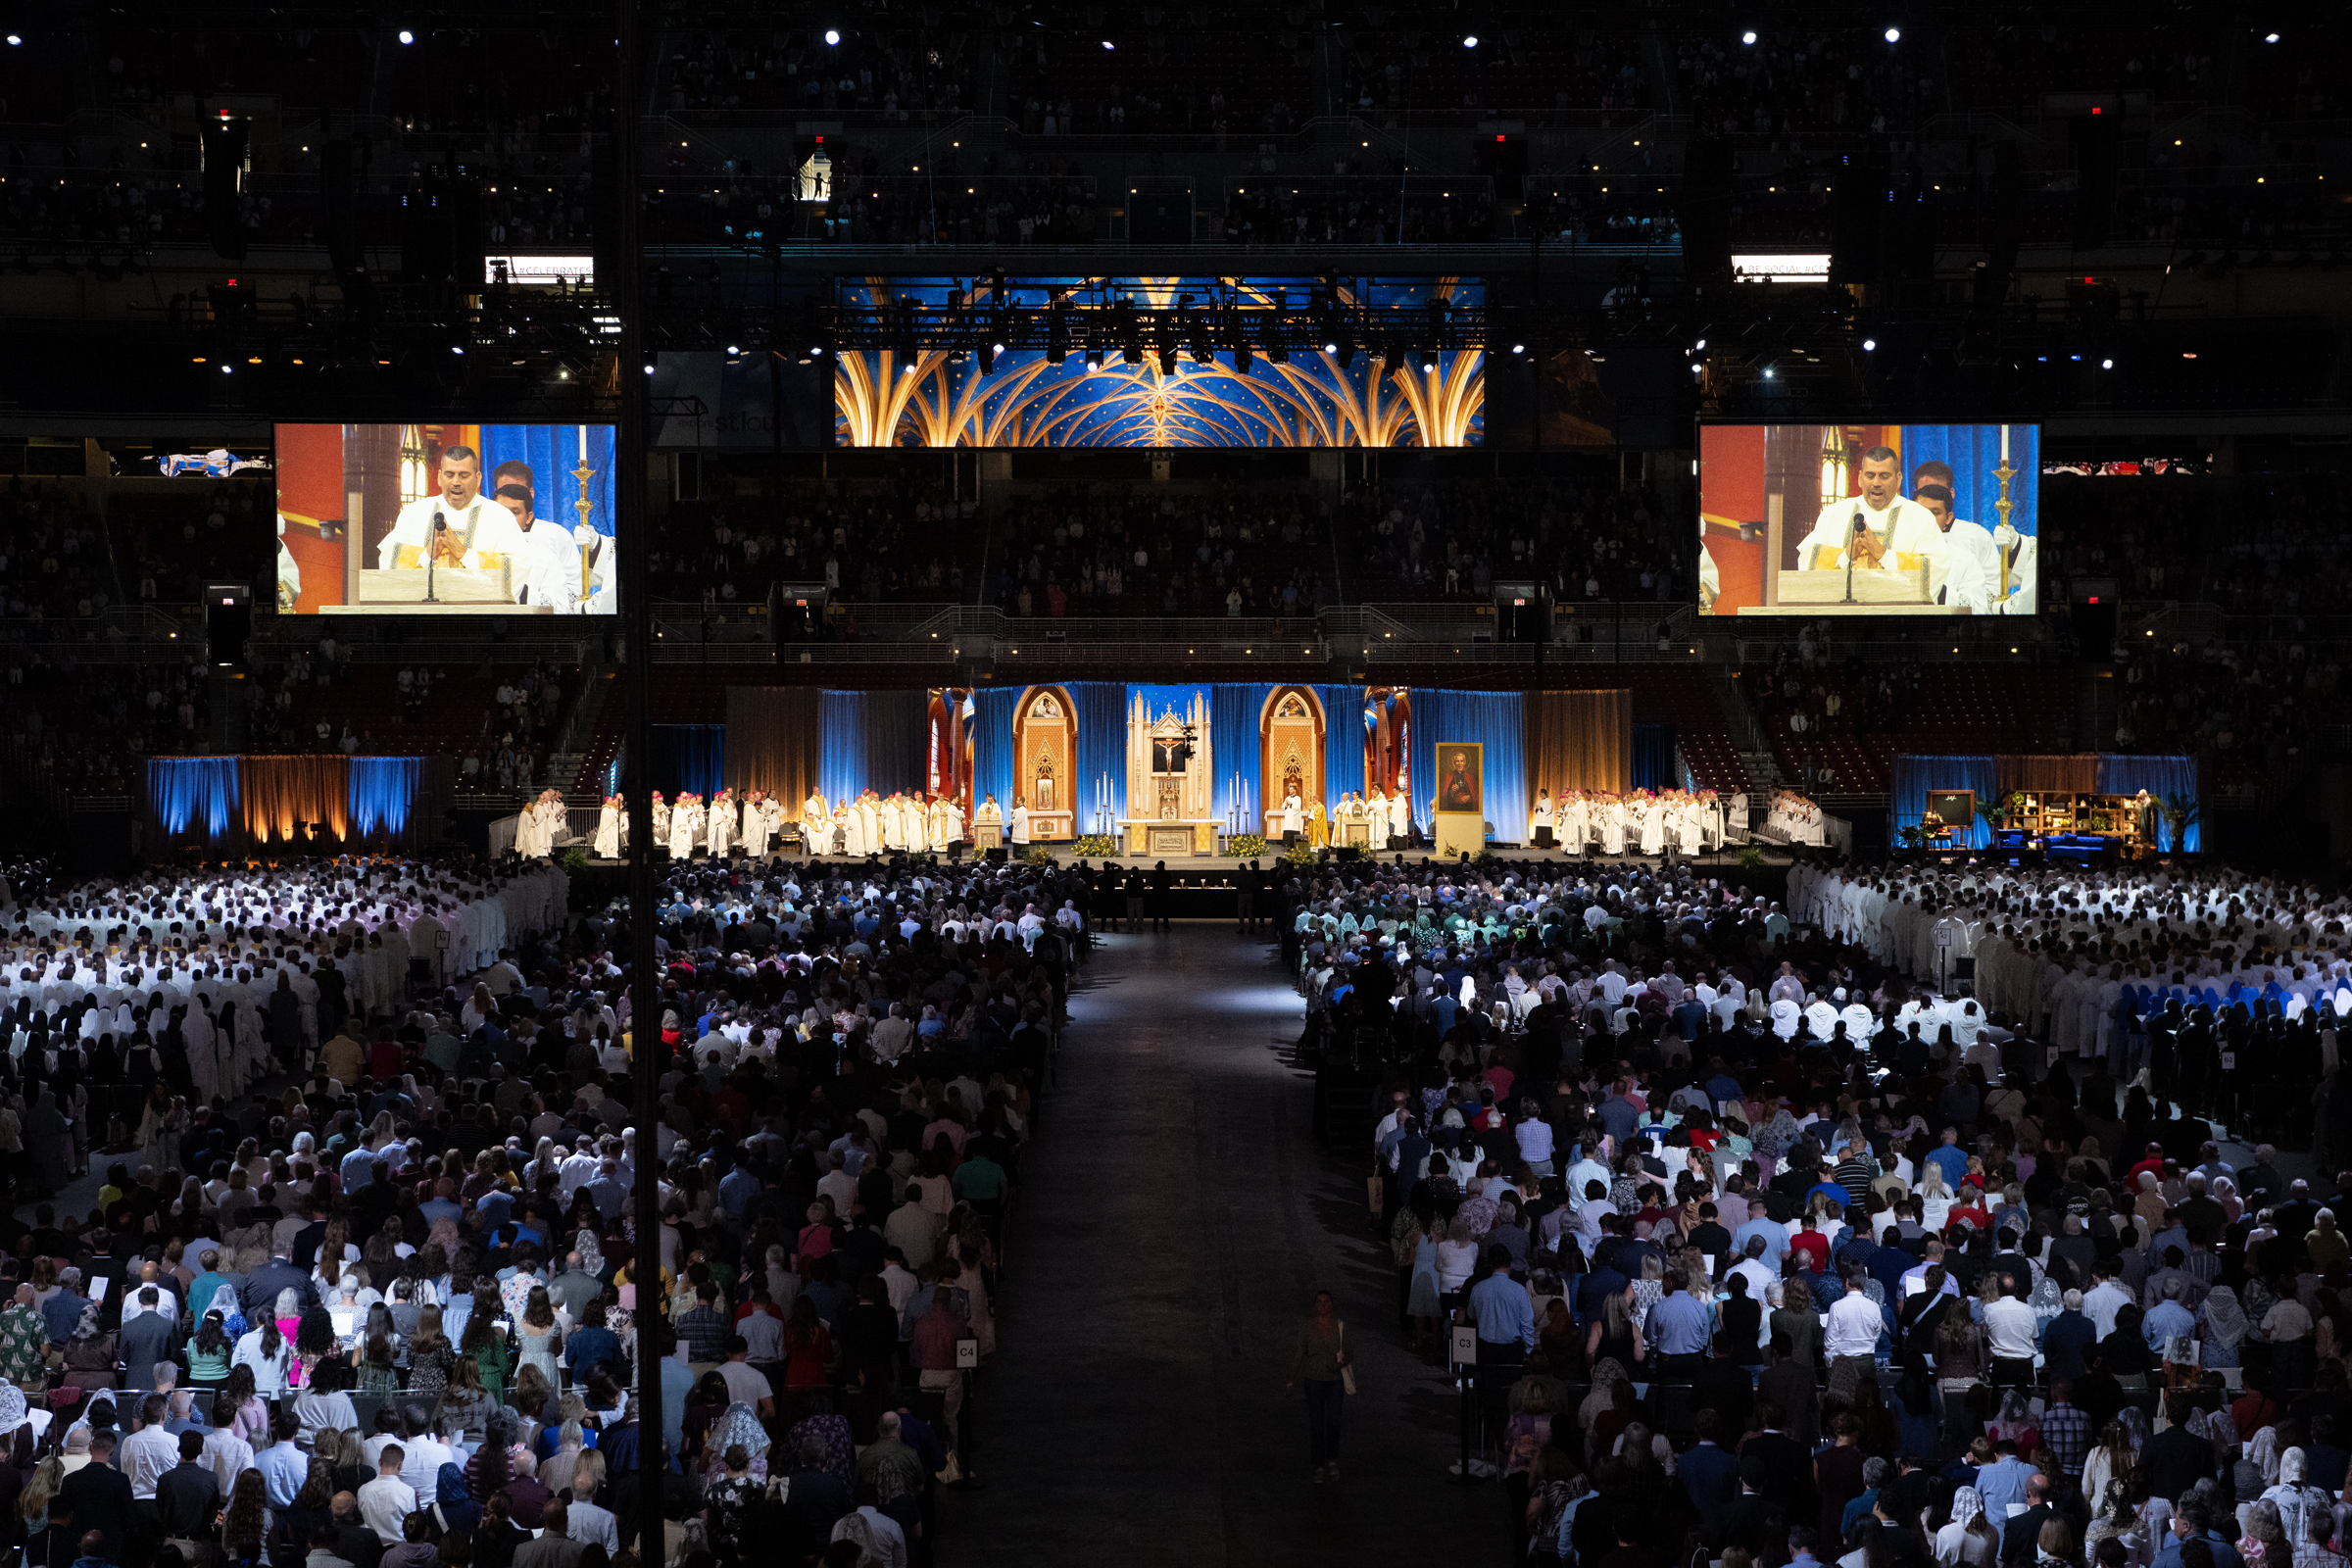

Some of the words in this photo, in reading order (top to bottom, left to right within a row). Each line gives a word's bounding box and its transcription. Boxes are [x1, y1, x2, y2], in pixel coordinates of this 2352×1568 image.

[678, 417, 713, 429] expore
[1459, 1339, 1471, 1348] C3
[960, 1348, 973, 1356] C4
